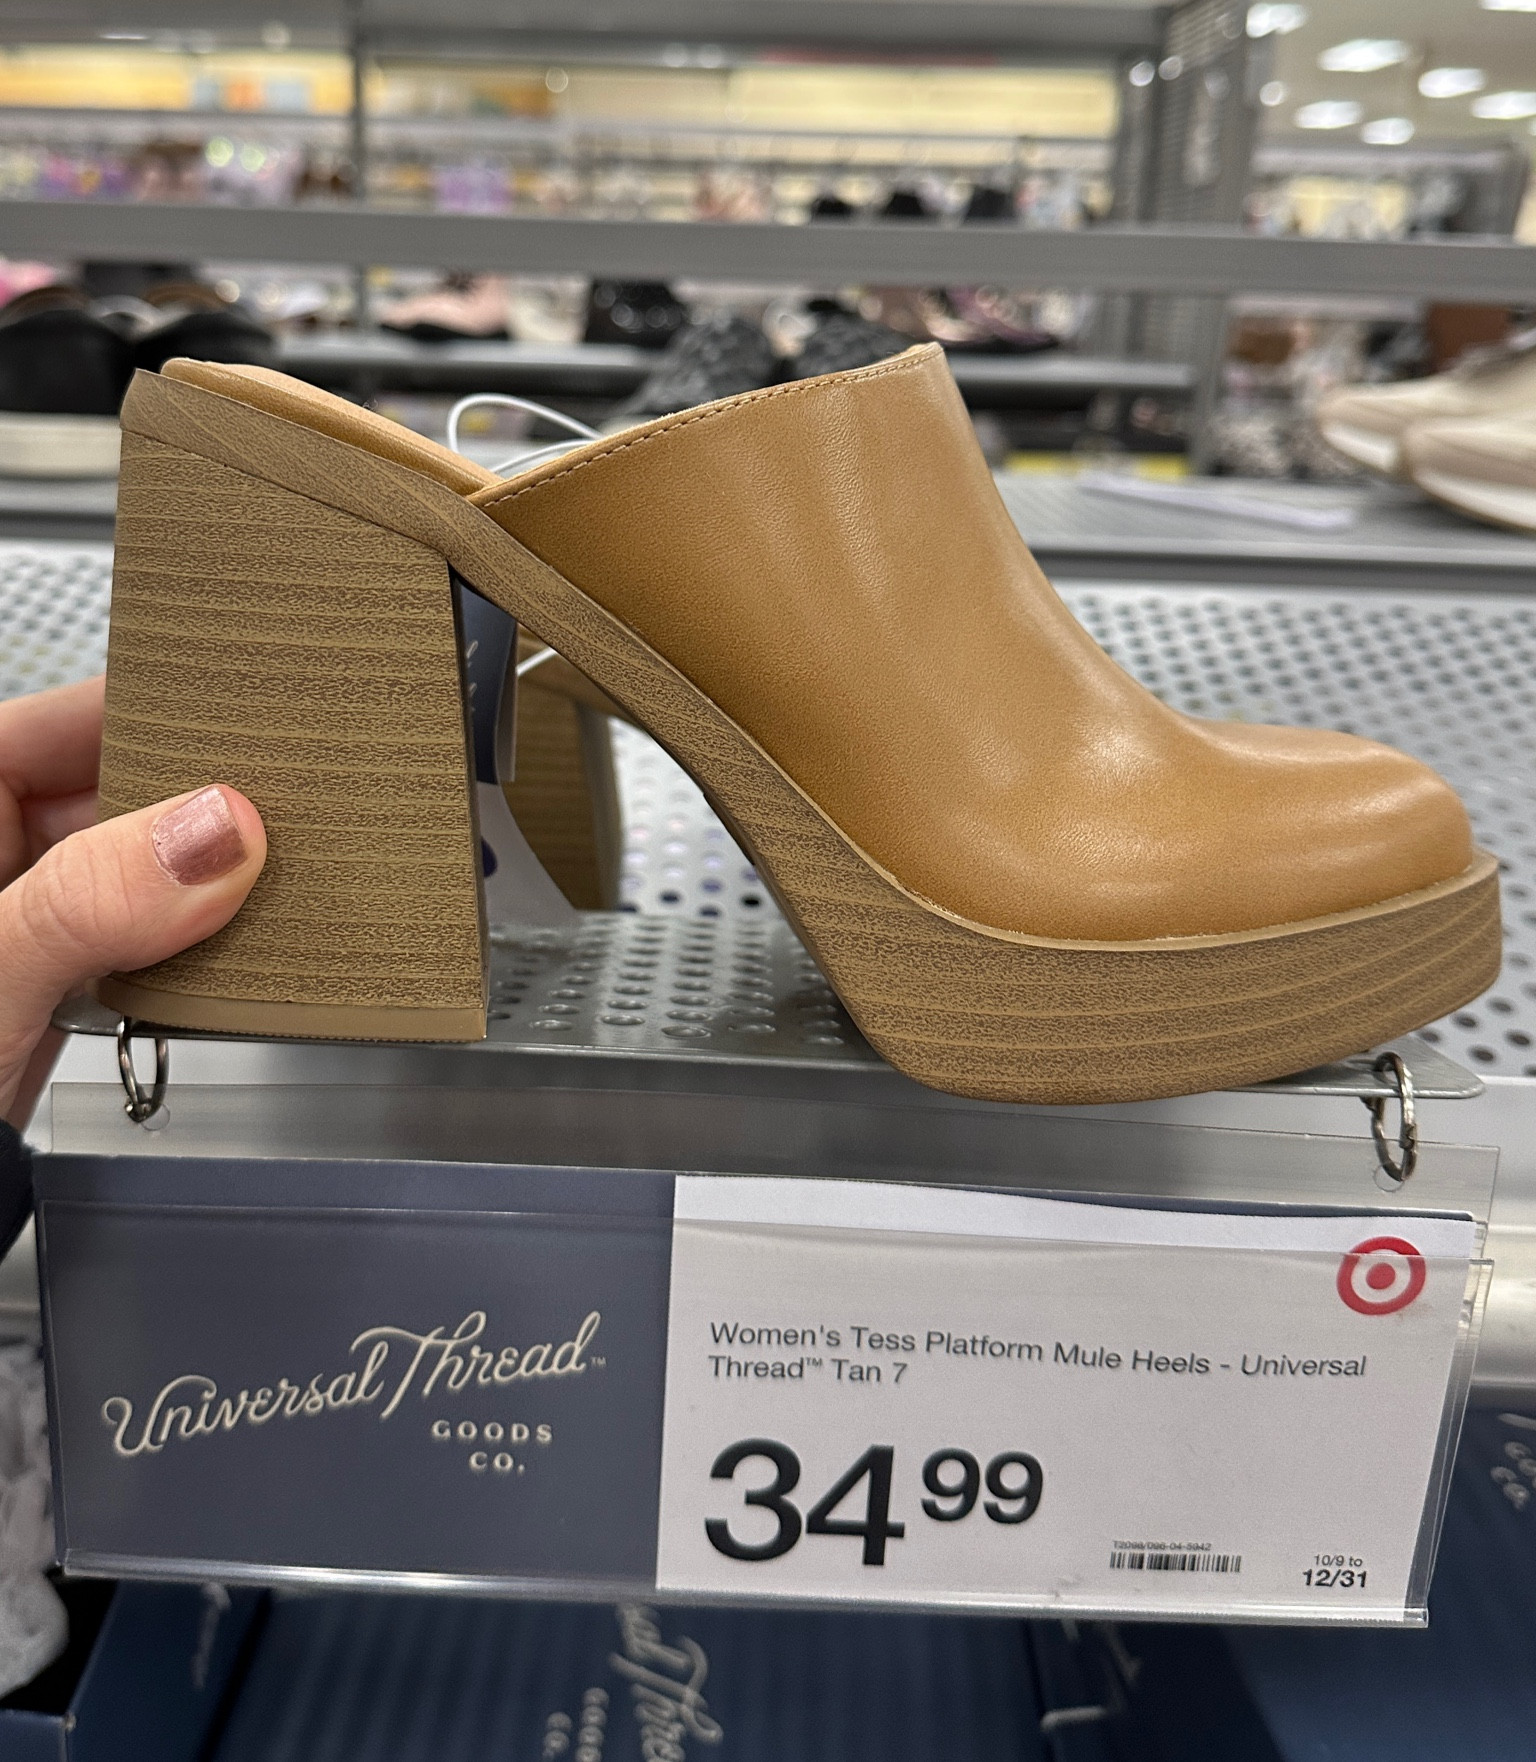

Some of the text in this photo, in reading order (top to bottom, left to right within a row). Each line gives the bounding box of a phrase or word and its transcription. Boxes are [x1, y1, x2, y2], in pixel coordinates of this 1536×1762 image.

[711, 1321, 841, 1347] Women's
[850, 1326, 916, 1351] Tess
[925, 1331, 1042, 1360] Platform
[1053, 1341, 1121, 1369] Mule
[1131, 1349, 1210, 1374] Heels
[1240, 1353, 1367, 1376] Universal
[831, 1358, 882, 1383] Tan
[892, 1362, 908, 1383] 7
[102, 1339, 389, 1457] Universal
[431, 1419, 553, 1443] GOODS
[469, 1450, 526, 1473] CO.
[1314, 1554, 1363, 1567] 10/9 to
[1302, 1568, 1367, 1588] 12/31
